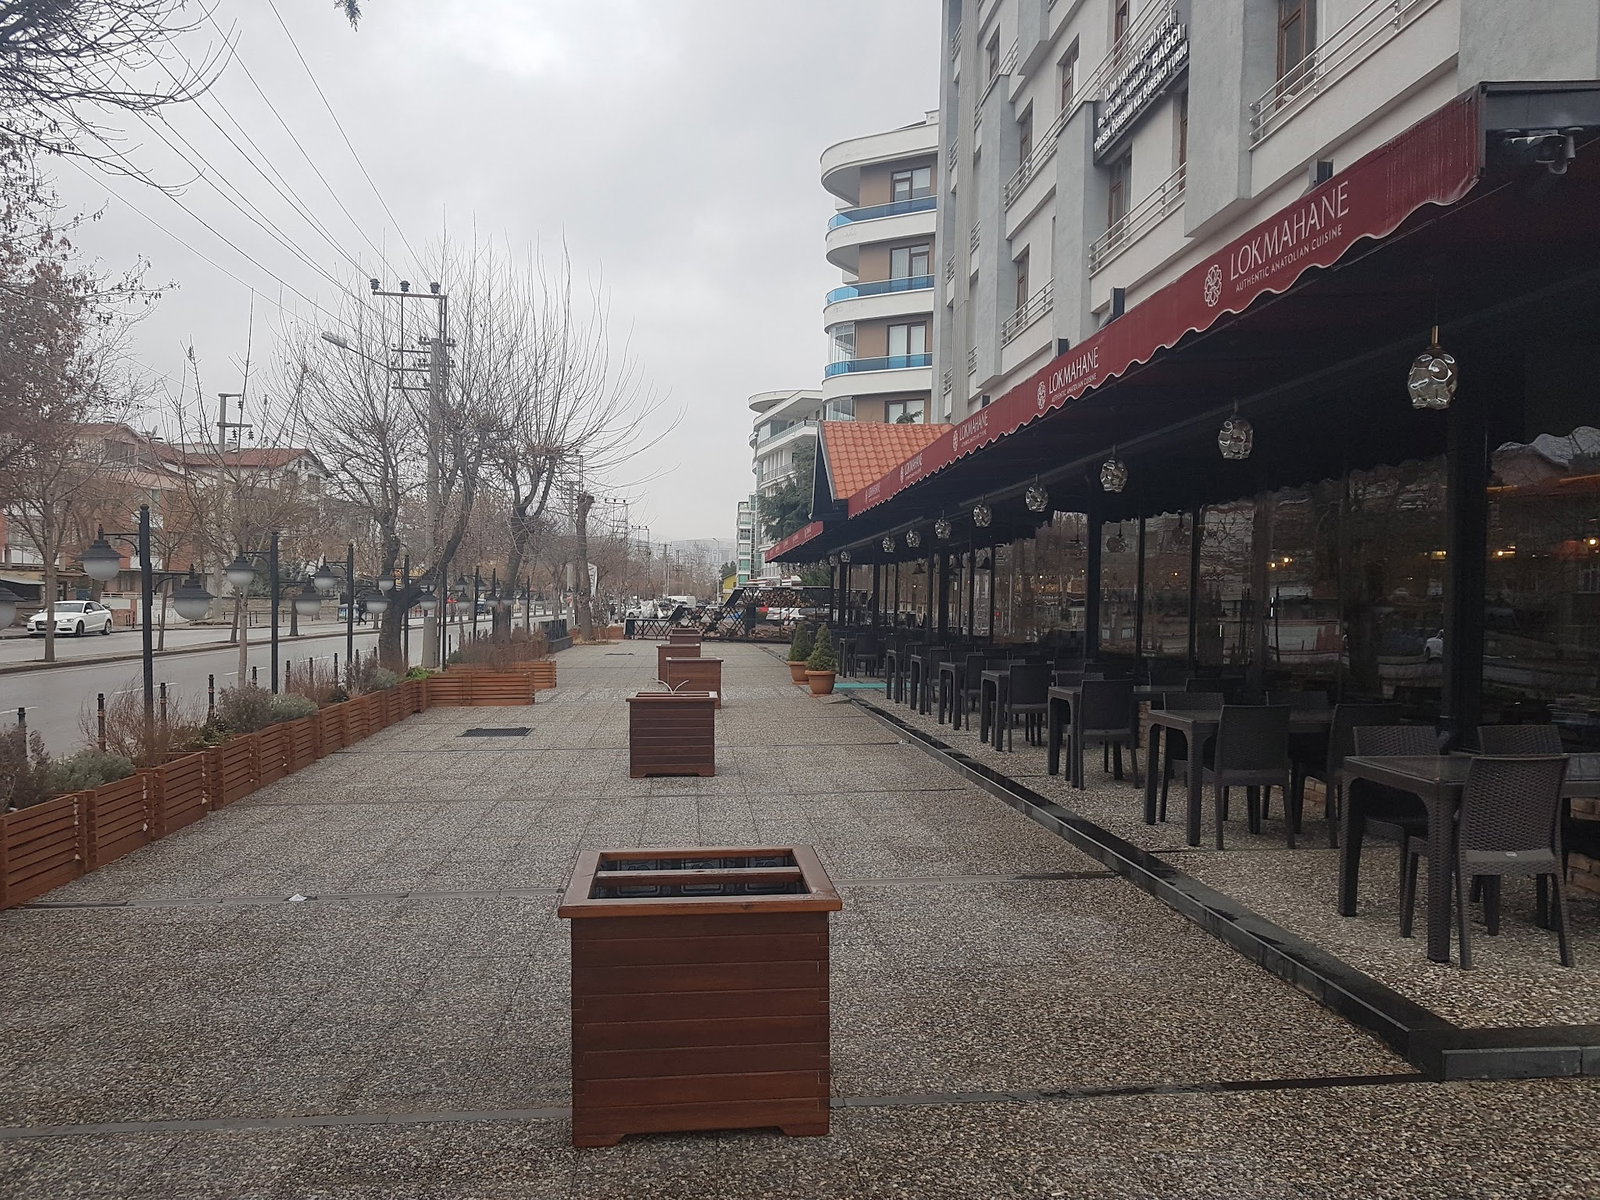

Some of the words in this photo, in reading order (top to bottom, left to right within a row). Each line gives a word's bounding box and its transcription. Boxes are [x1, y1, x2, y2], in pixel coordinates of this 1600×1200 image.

[1230, 180, 1350, 281] LOKMAHANE
[1235, 266, 1270, 292] AUTHENTIC
[1271, 243, 1310, 275] ANATOLIAN
[1311, 223, 1343, 251] CUISINE
[1048, 346, 1099, 394] LOKMAHANE
[959, 409, 988, 441] LOKMAHANE
